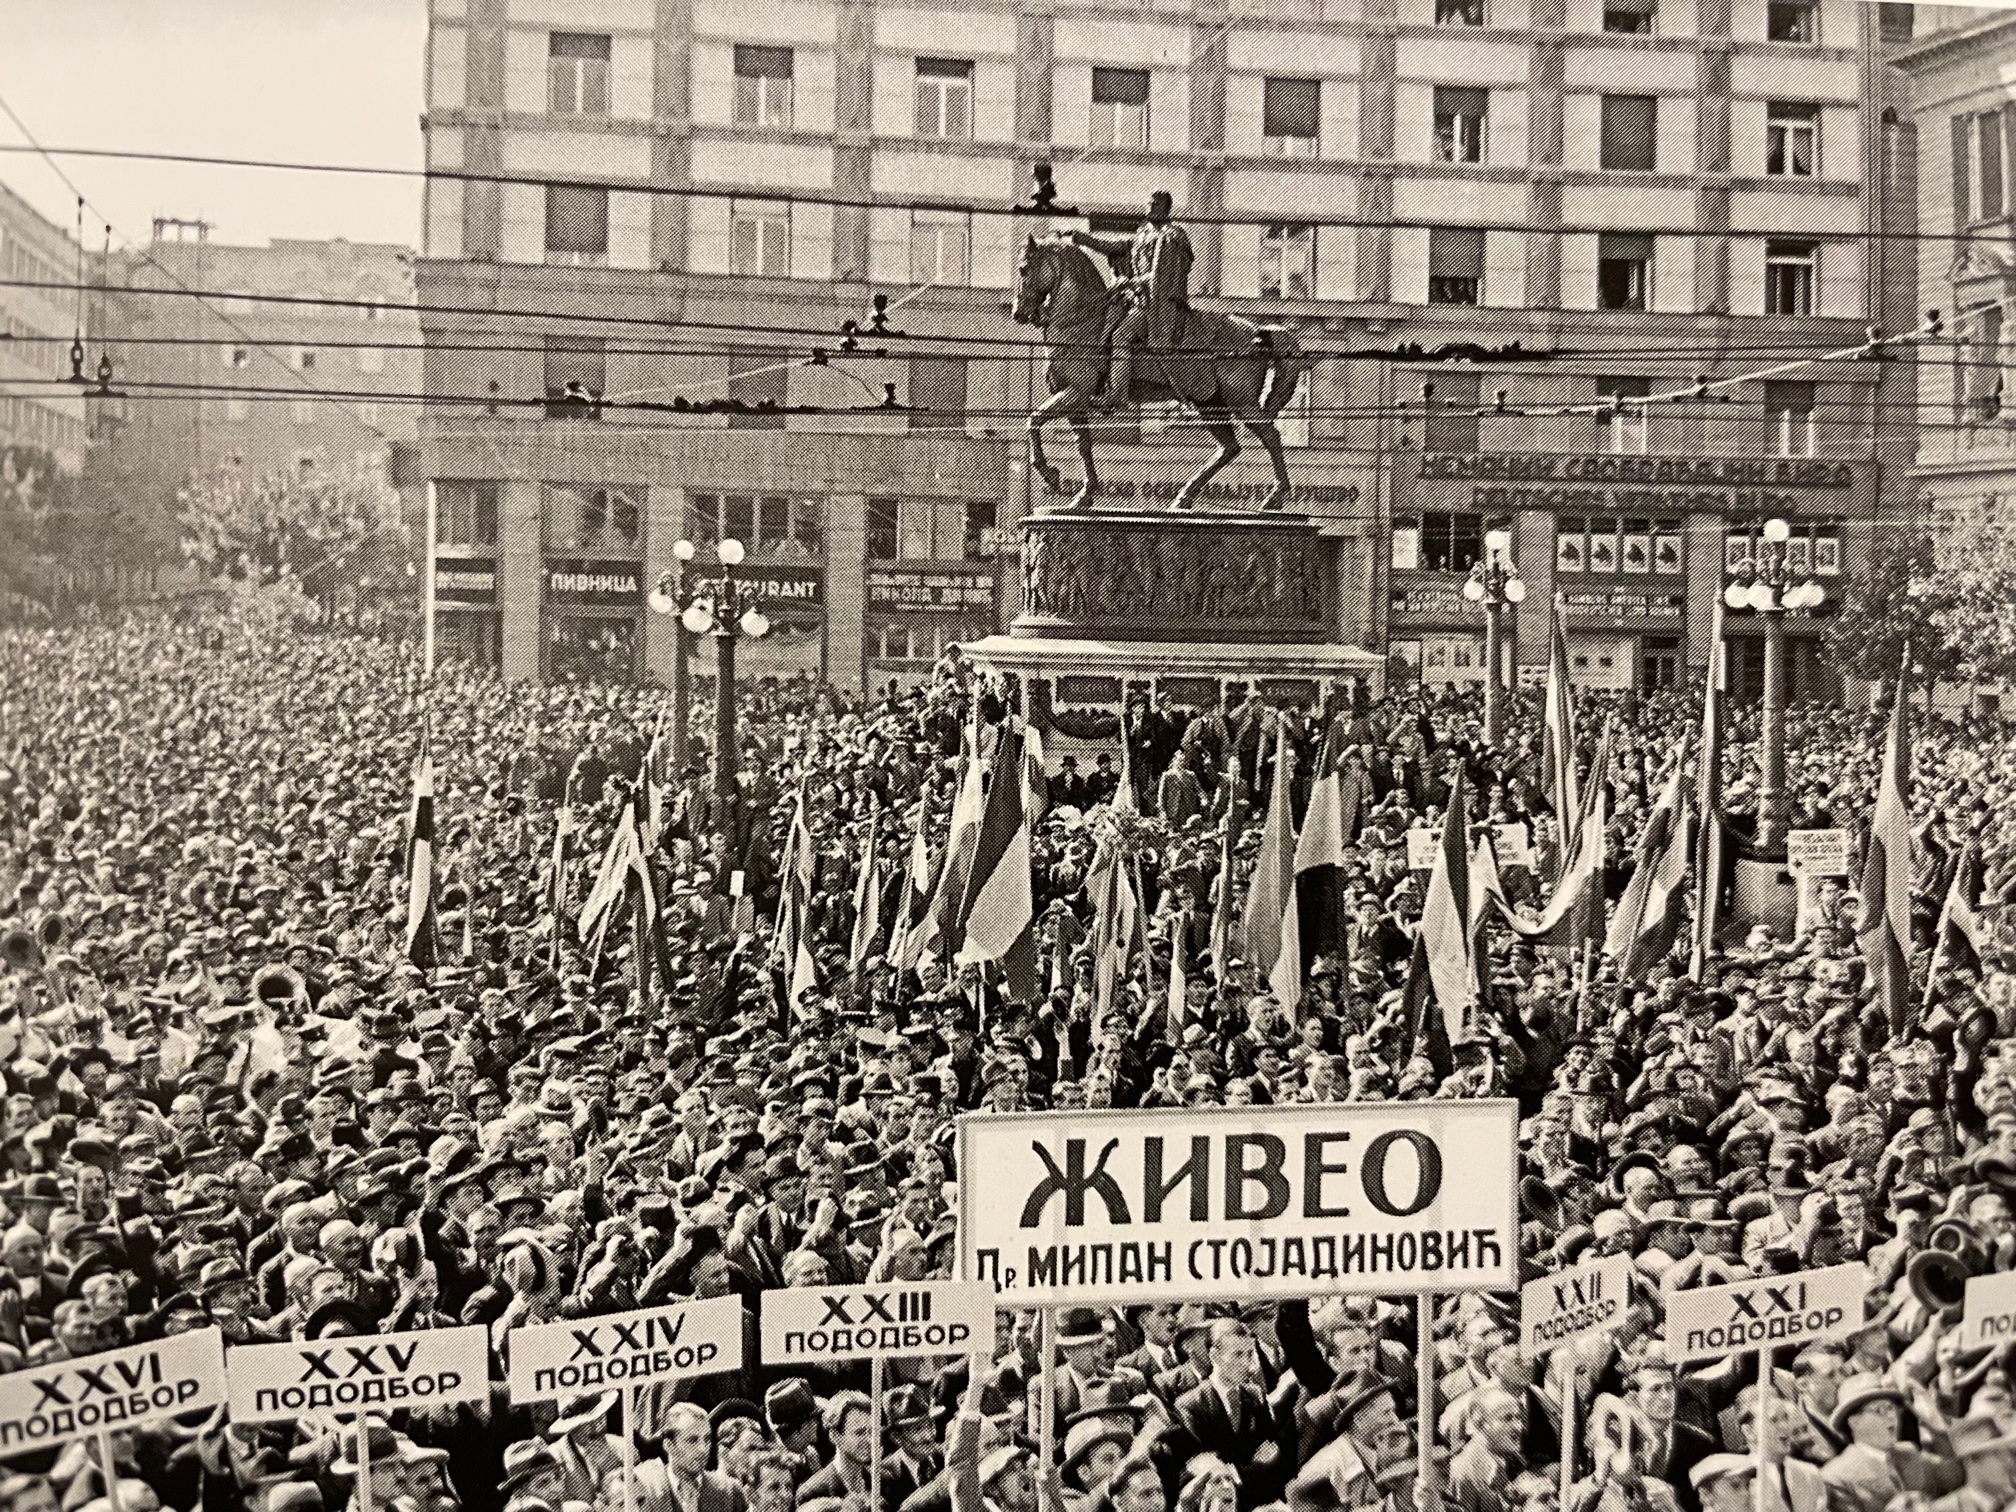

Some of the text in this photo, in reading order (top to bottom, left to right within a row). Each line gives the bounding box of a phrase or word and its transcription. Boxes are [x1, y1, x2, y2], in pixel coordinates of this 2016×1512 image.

[551, 573, 637, 592] ПИВНИЦА
[1019, 1128, 1443, 1229] ЖИВЕО
[1027, 1241, 1173, 1288] МИЛАН
[1187, 1228, 1501, 1280] СТОЈАДИНОВИЋ
[819, 1291, 932, 1326] XXIII
[1551, 1269, 1602, 1315] XXII
[1730, 1281, 1808, 1323] XXI
[569, 1312, 686, 1362] XXIV
[785, 1323, 970, 1354] ПОДОДБОР
[1686, 1306, 1844, 1351] ПОДОДБОР
[32, 1352, 162, 1411] XXVI
[299, 1341, 418, 1383] XXV
[535, 1342, 718, 1392] ПОДОДБОР
[1, 1378, 200, 1445] ПОДОДБОР
[256, 1372, 462, 1411] ПОДОДБОР
